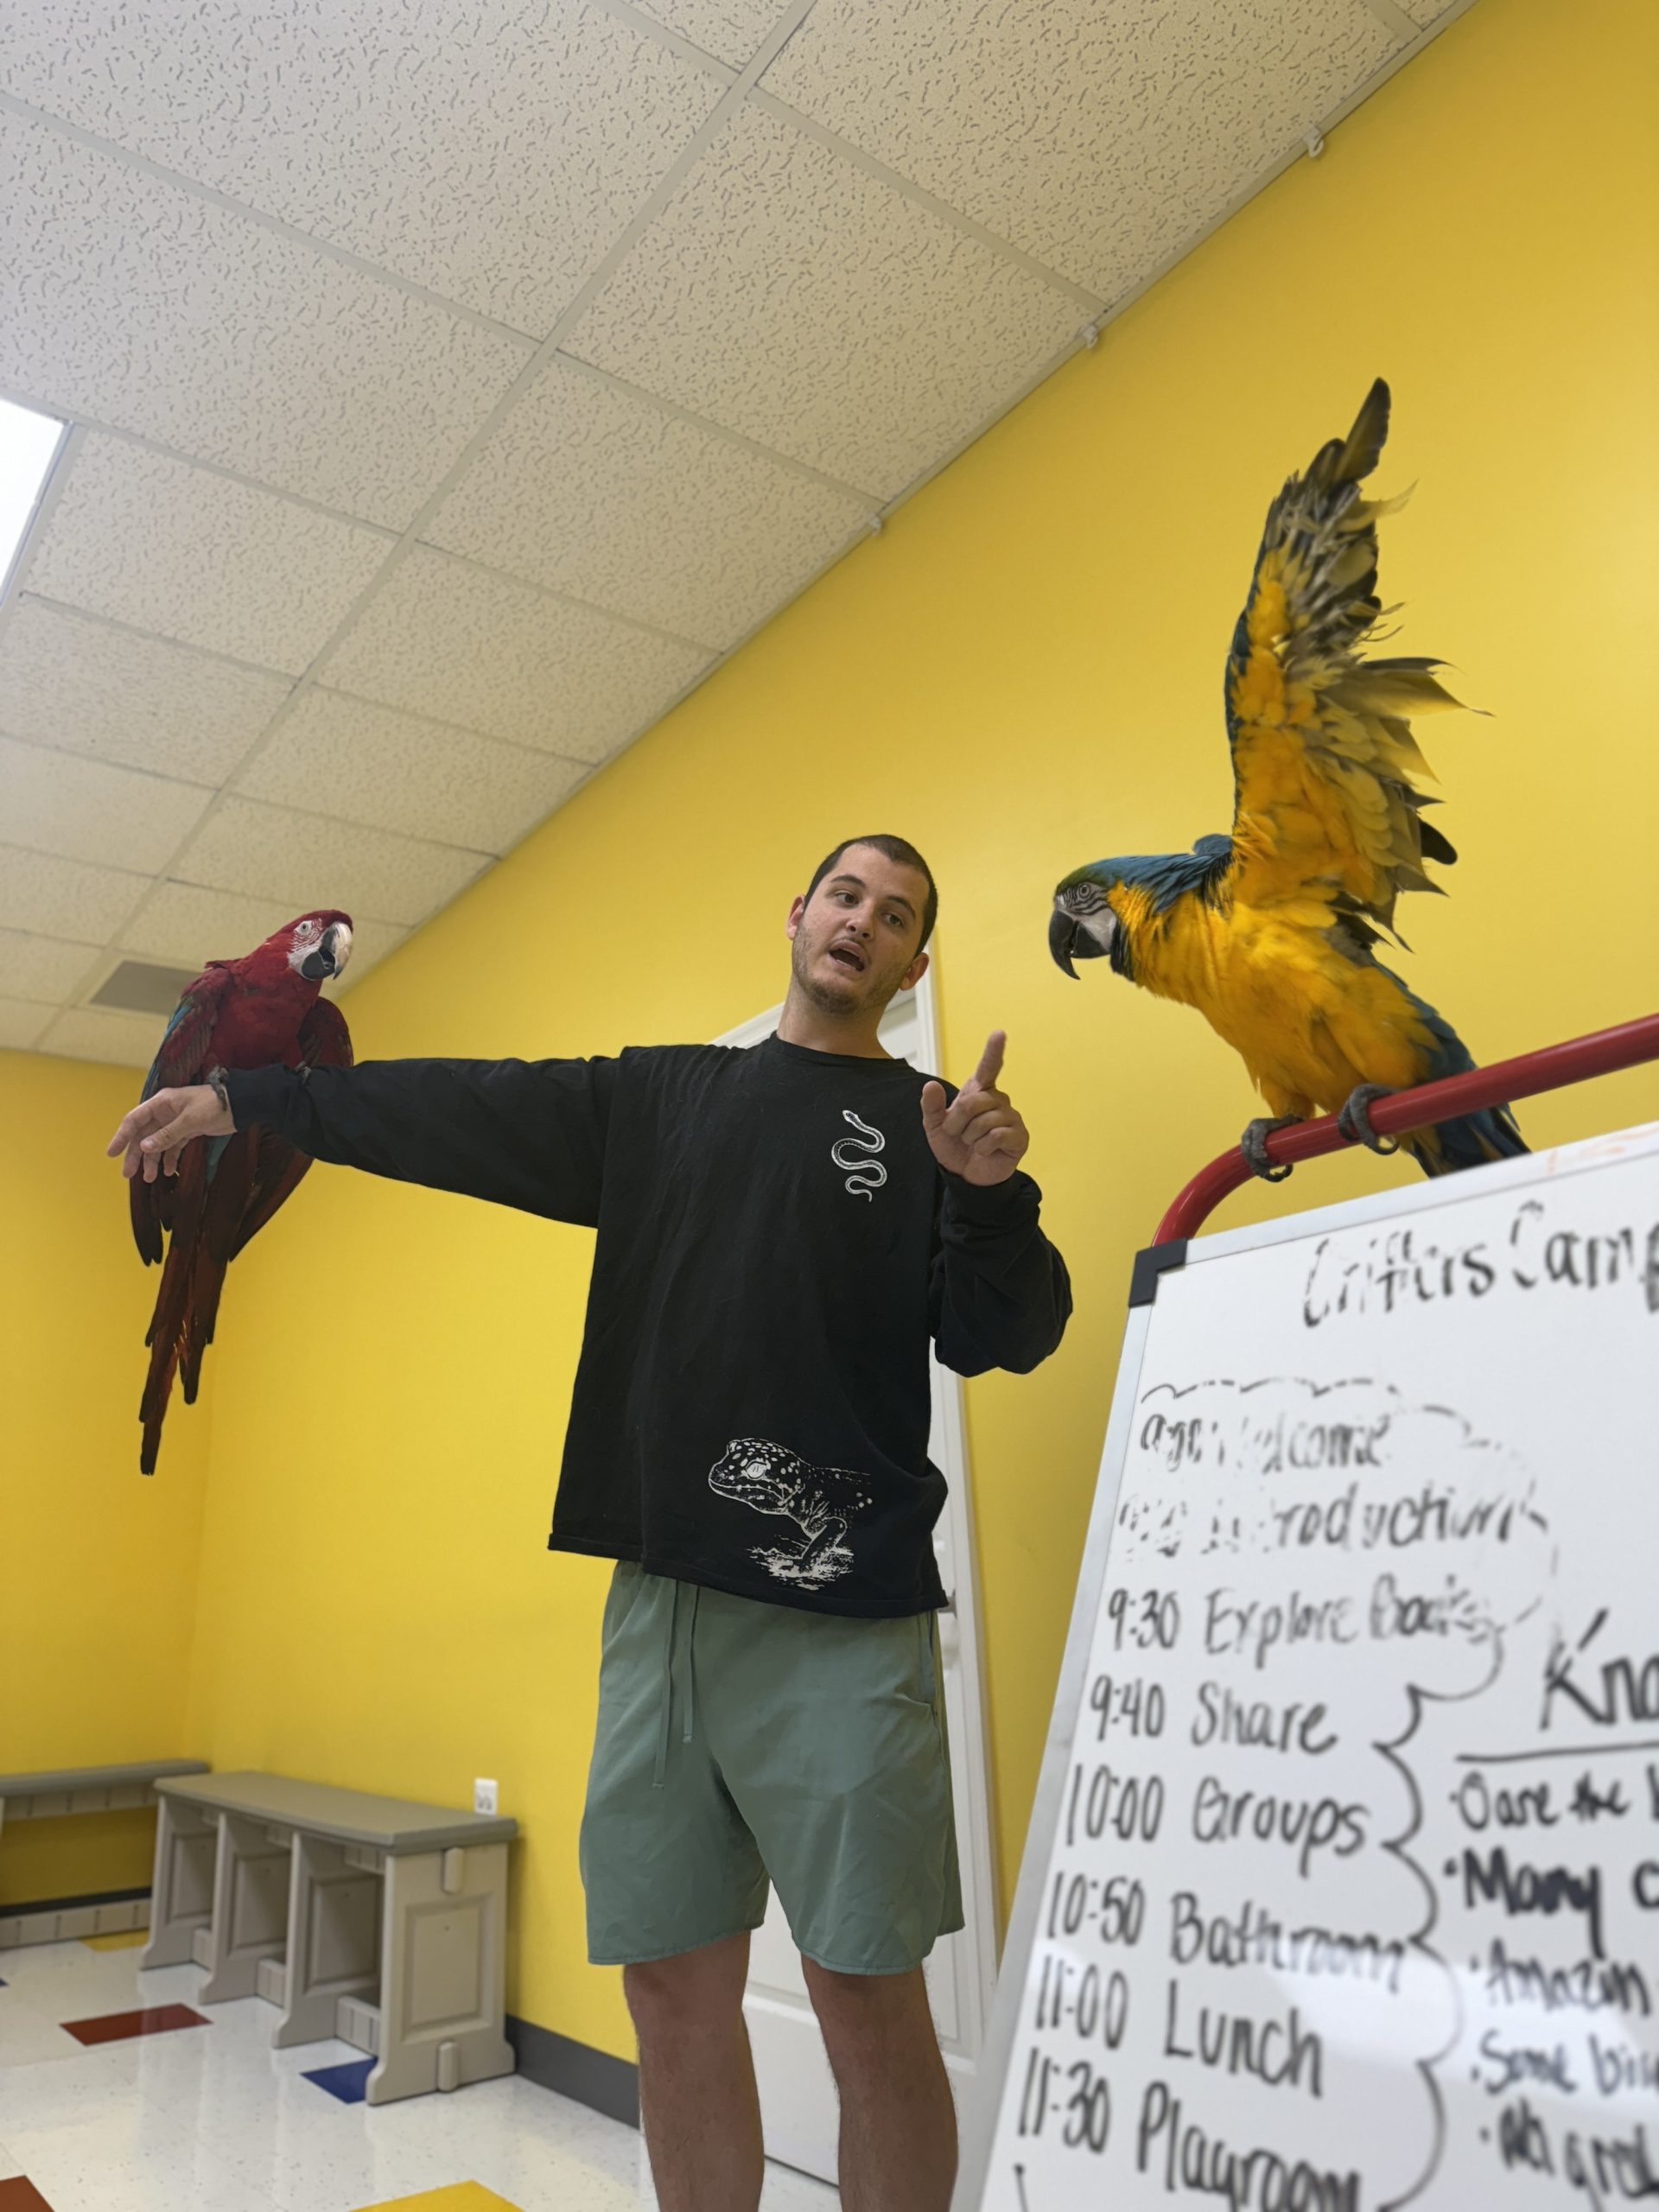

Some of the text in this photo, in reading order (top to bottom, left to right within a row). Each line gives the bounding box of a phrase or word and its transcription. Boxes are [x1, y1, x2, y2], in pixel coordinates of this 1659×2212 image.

[1109, 1588, 1180, 1652] 9:30
[1206, 1587, 1357, 1670] Explore
[1090, 1675, 1338, 1755] 9:40 Share
[1066, 1764, 1371, 1879] 10:00 Groups
[1568, 1770, 1630, 1824] the
[1170, 1891, 1406, 1994] Bathroom
[1463, 1846, 1605, 1962] Many
[1037, 1955, 1322, 2099] 11:00 Lunch
[1479, 2028, 1577, 2096] Some
[1019, 2046, 1111, 2154] 11:30
[1136, 2081, 1362, 2212] Playroom
